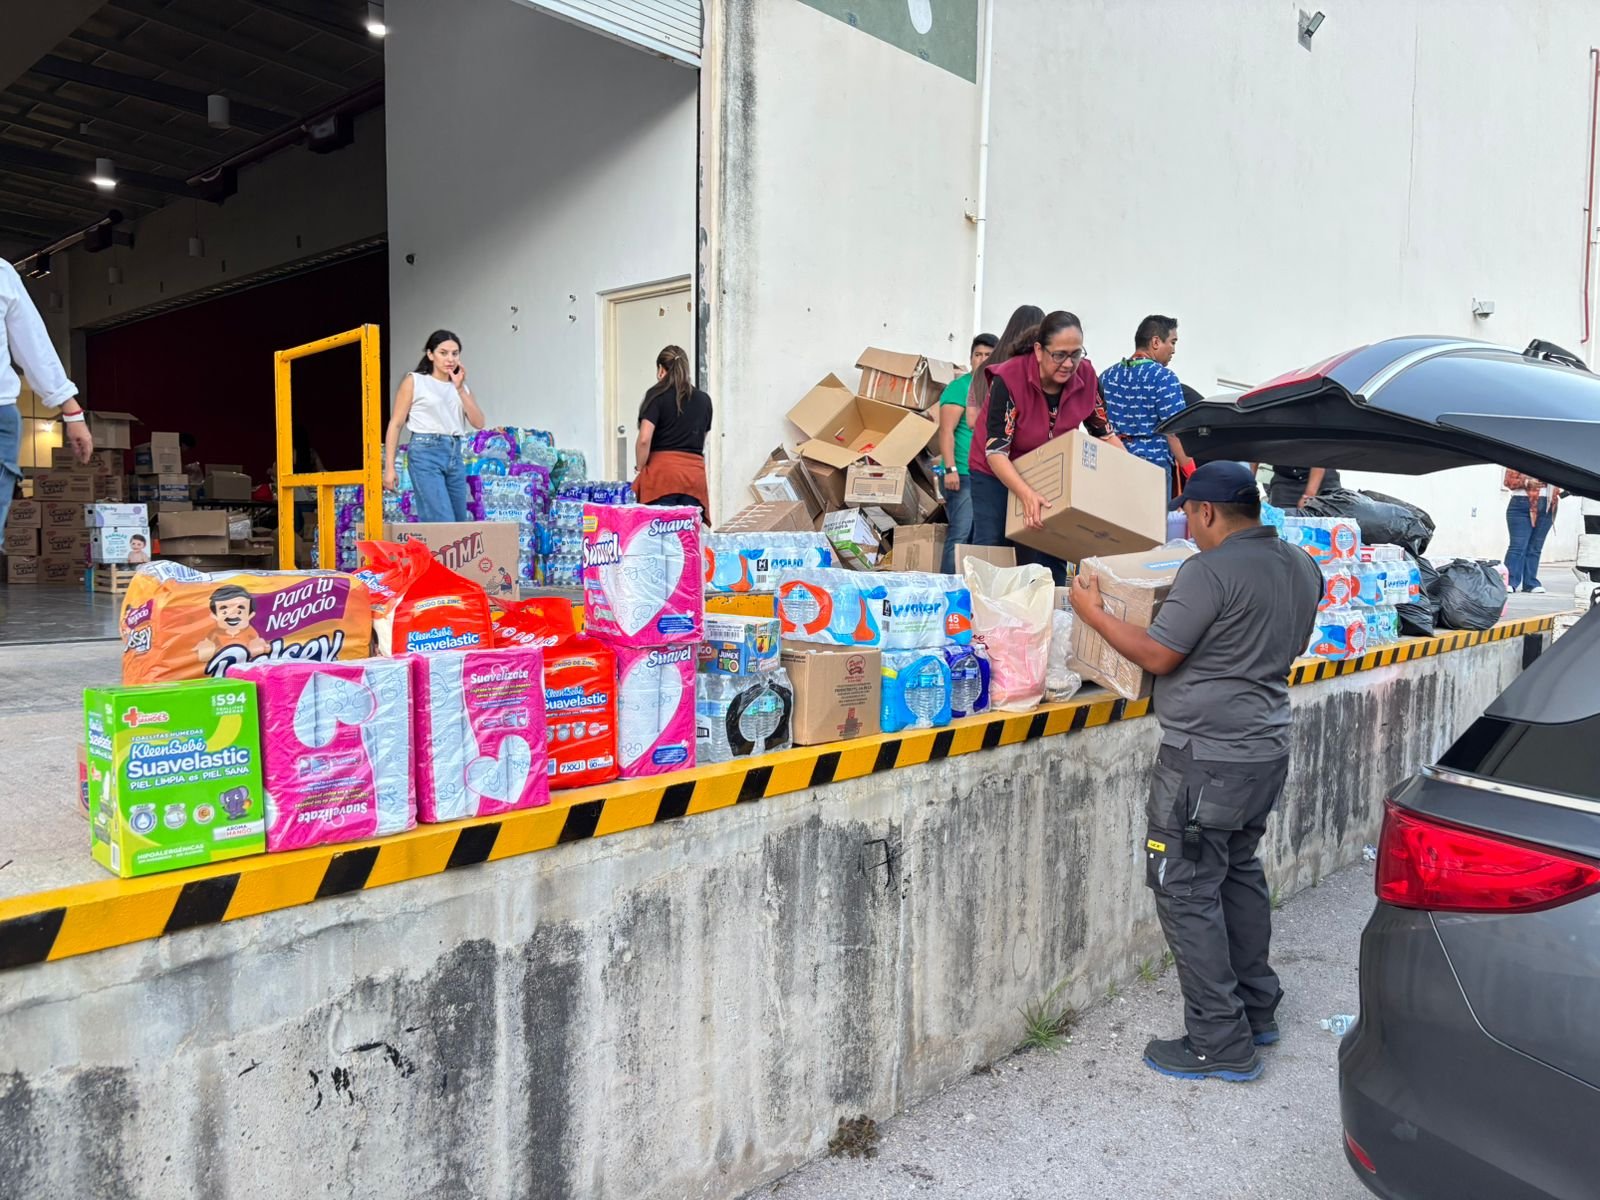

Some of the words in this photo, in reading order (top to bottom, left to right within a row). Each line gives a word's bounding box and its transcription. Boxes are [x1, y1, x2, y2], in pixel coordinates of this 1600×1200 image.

[582, 532, 619, 569] Suavel
[272, 584, 313, 611] Para
[316, 578, 334, 594] tu
[266, 594, 336, 632] Negocio
[948, 614, 959, 623] 45
[407, 632, 480, 653] Suavelastic
[647, 645, 692, 668] Suavel
[719, 651, 739, 660] JUMEX
[216, 692, 247, 707] 594
[131, 738, 206, 760] KleenBebé
[128, 747, 249, 778] Suavelastic
[130, 780, 151, 790] PIEL
[155, 774, 185, 786] LIMPIA
[203, 771, 221, 779] PIEL
[225, 766, 249, 775] SANA
[226, 824, 247, 832] AROMA
[226, 828, 252, 836] MANGO
